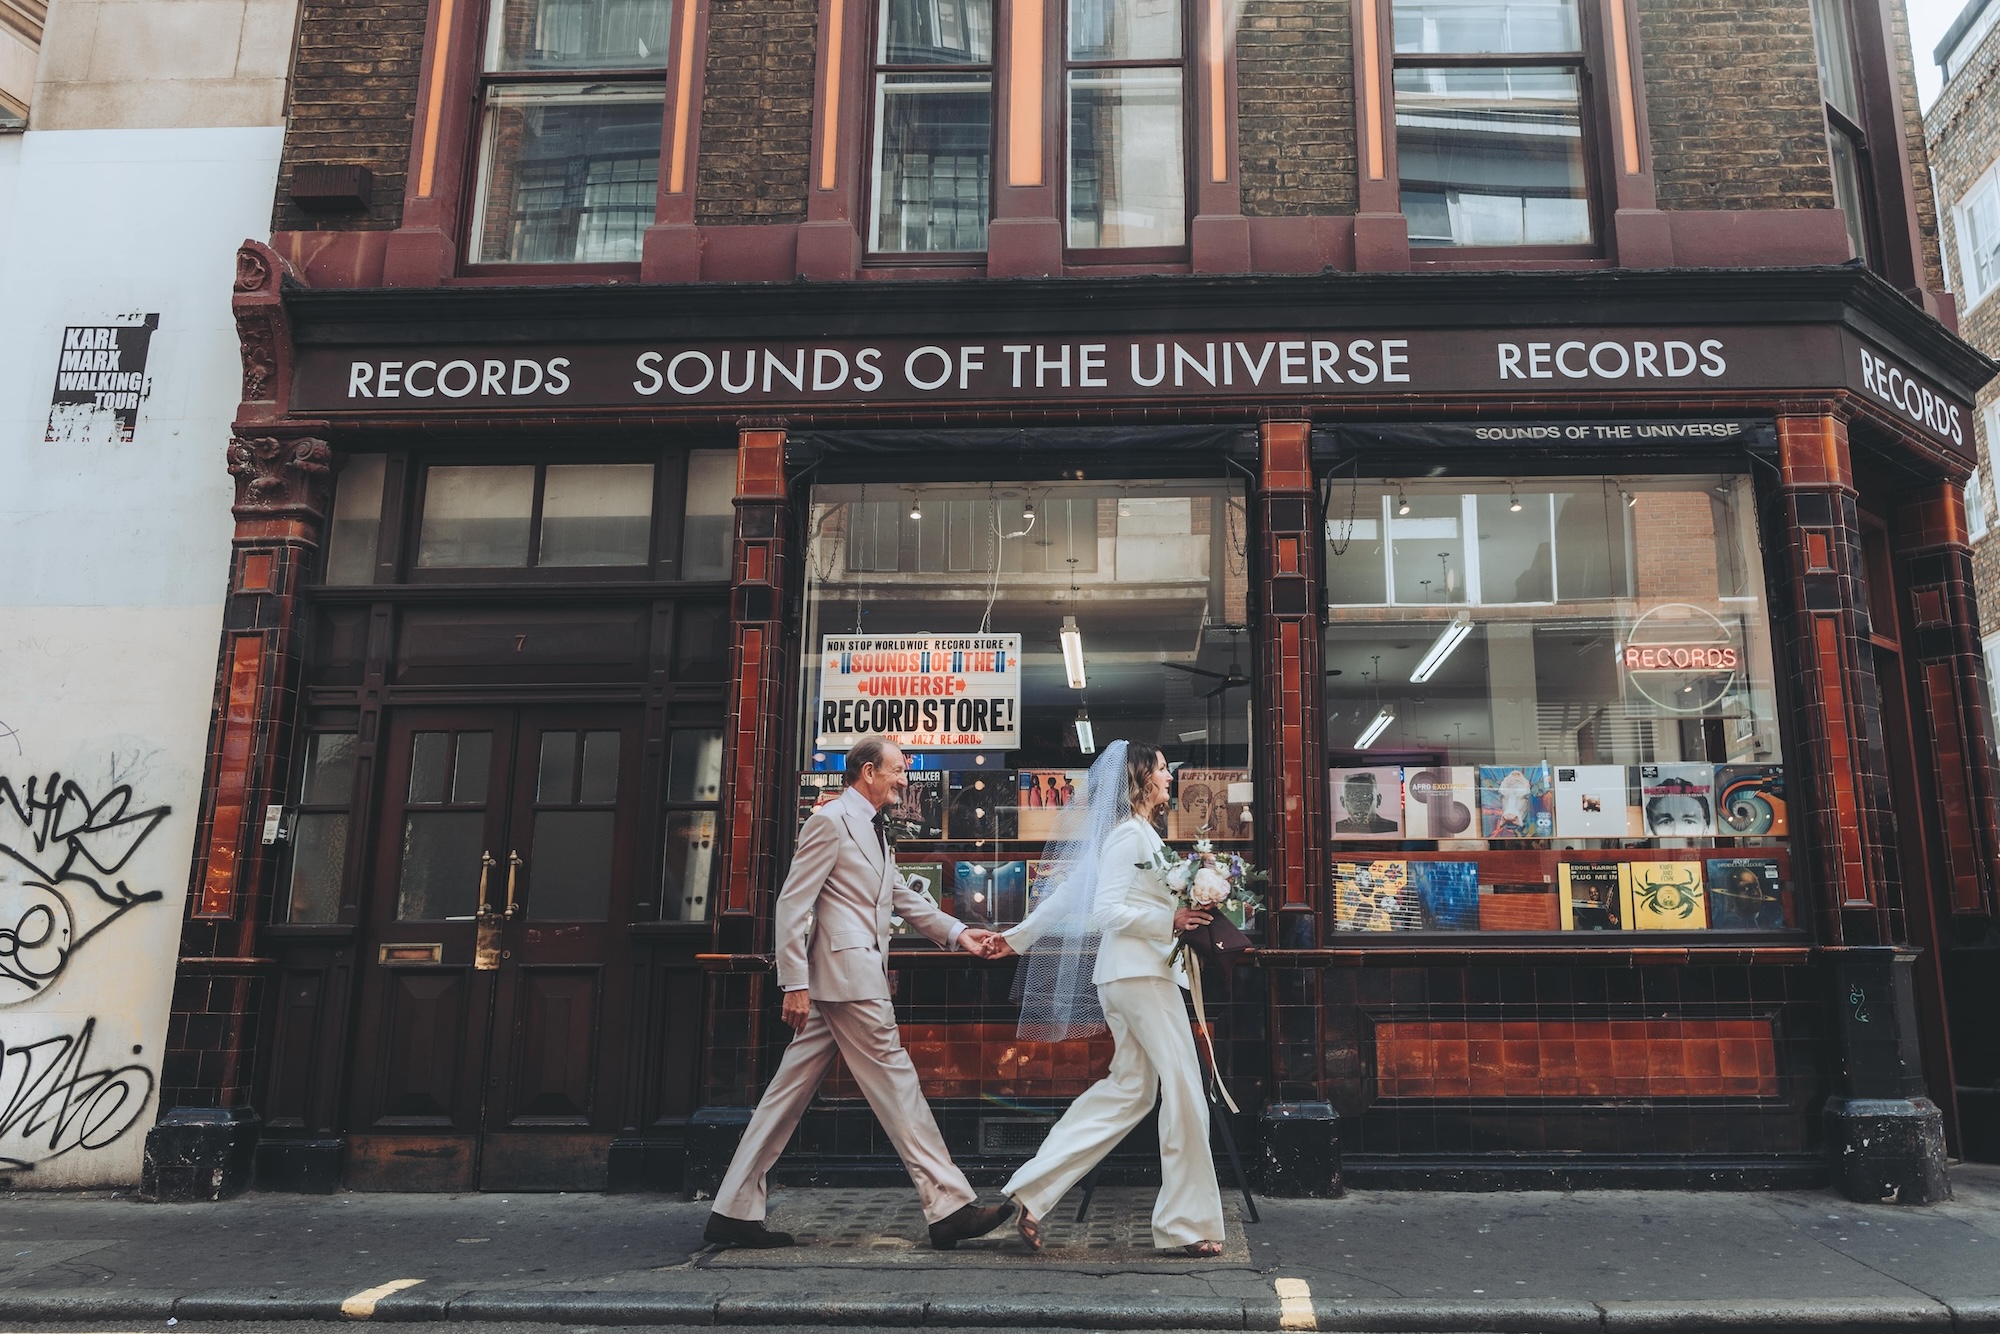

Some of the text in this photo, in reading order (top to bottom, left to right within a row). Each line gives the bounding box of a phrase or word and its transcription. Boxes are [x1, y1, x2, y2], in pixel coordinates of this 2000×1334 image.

[64, 328, 119, 350] KARL
[60, 351, 121, 371] MARX
[633, 340, 1410, 395] SOUNDS OF THE UNIVERSE
[1498, 340, 1726, 379] RECORDS
[59, 372, 143, 391] WALKING
[348, 358, 570, 397] RECORDS
[95, 392, 138, 410] TOUR
[1860, 348, 1962, 445] RECORDS
[1475, 423, 1742, 441] SOUNDS OF THE UNIVERSE
[515, 634, 526, 653] 7
[827, 639, 1004, 651] NON STOP WORLDWIDE RECORD STORE
[851, 652, 995, 673] SOUNDS OF THE
[1626, 648, 1737, 668] RECORDS
[869, 675, 955, 697] UNIVERSE
[911, 734, 935, 745] JAZZ
[940, 734, 982, 745] RECORDS
[828, 773, 844, 786] ONE
[909, 771, 941, 782] WALKER
[1181, 771, 1209, 781] RUFFY
[1212, 771, 1243, 781] TUFFY
[1412, 783, 1431, 791] AFRO
